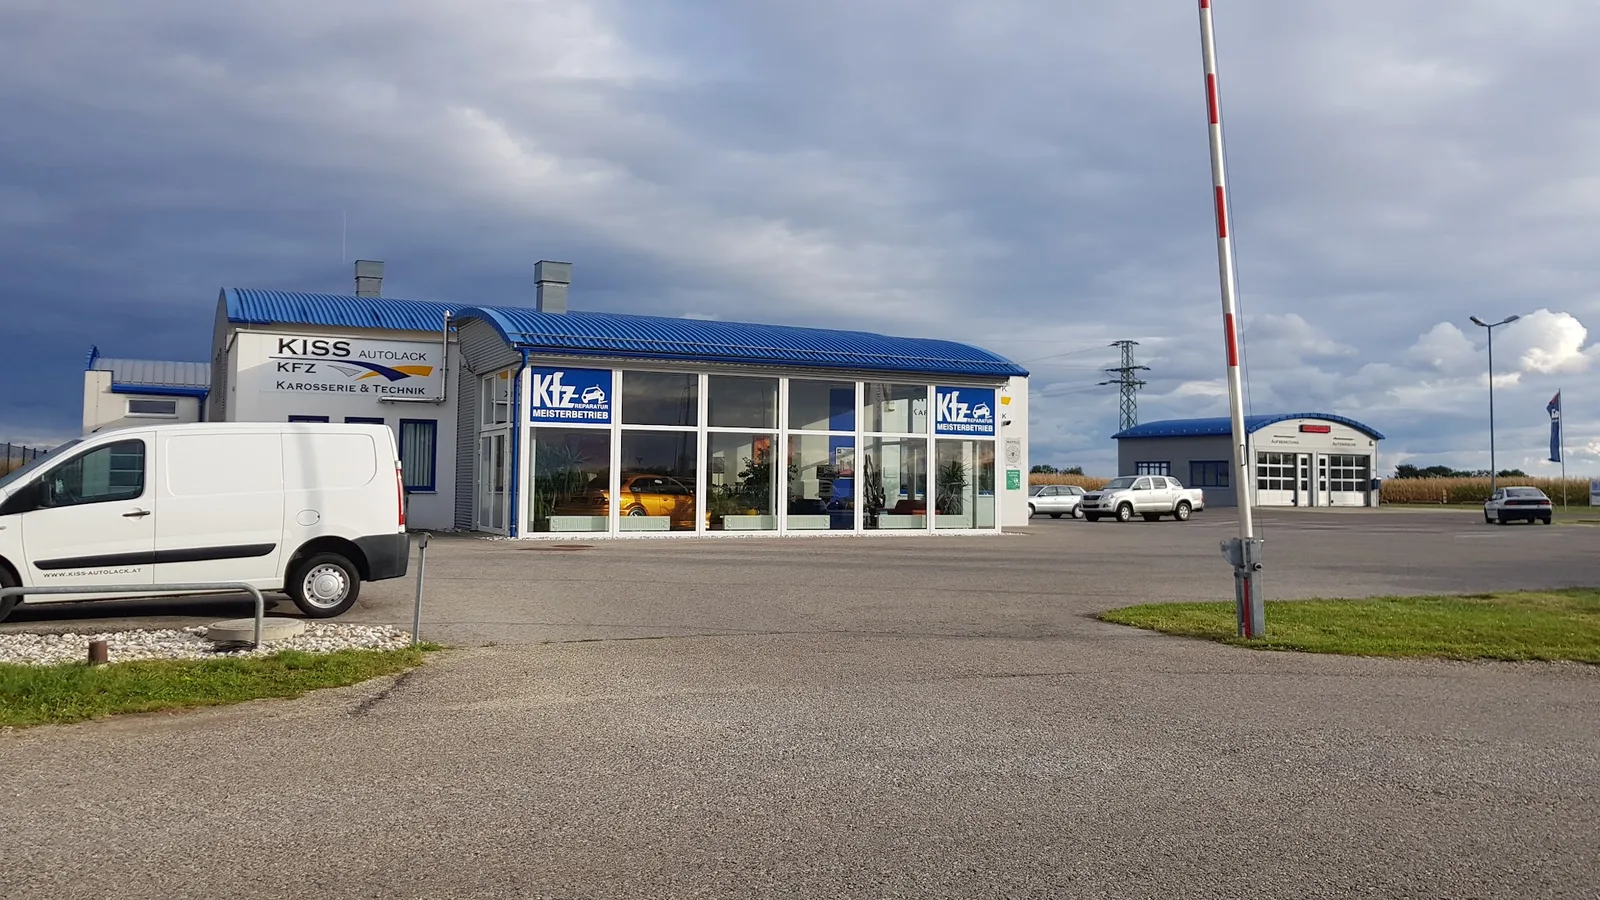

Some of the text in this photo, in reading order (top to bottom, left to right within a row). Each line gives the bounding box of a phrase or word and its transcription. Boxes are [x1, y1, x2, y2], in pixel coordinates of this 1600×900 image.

[278, 338, 427, 361] KISS AUTOLACK
[277, 362, 317, 374] KFZ
[276, 380, 426, 395] KAROSSERIE & TECHNIK
[533, 371, 579, 408] Kfz
[532, 409, 609, 419] MEISTERBETRIEB
[937, 391, 971, 422] Kfz
[936, 423, 993, 432] MEISTERBETRIEB
